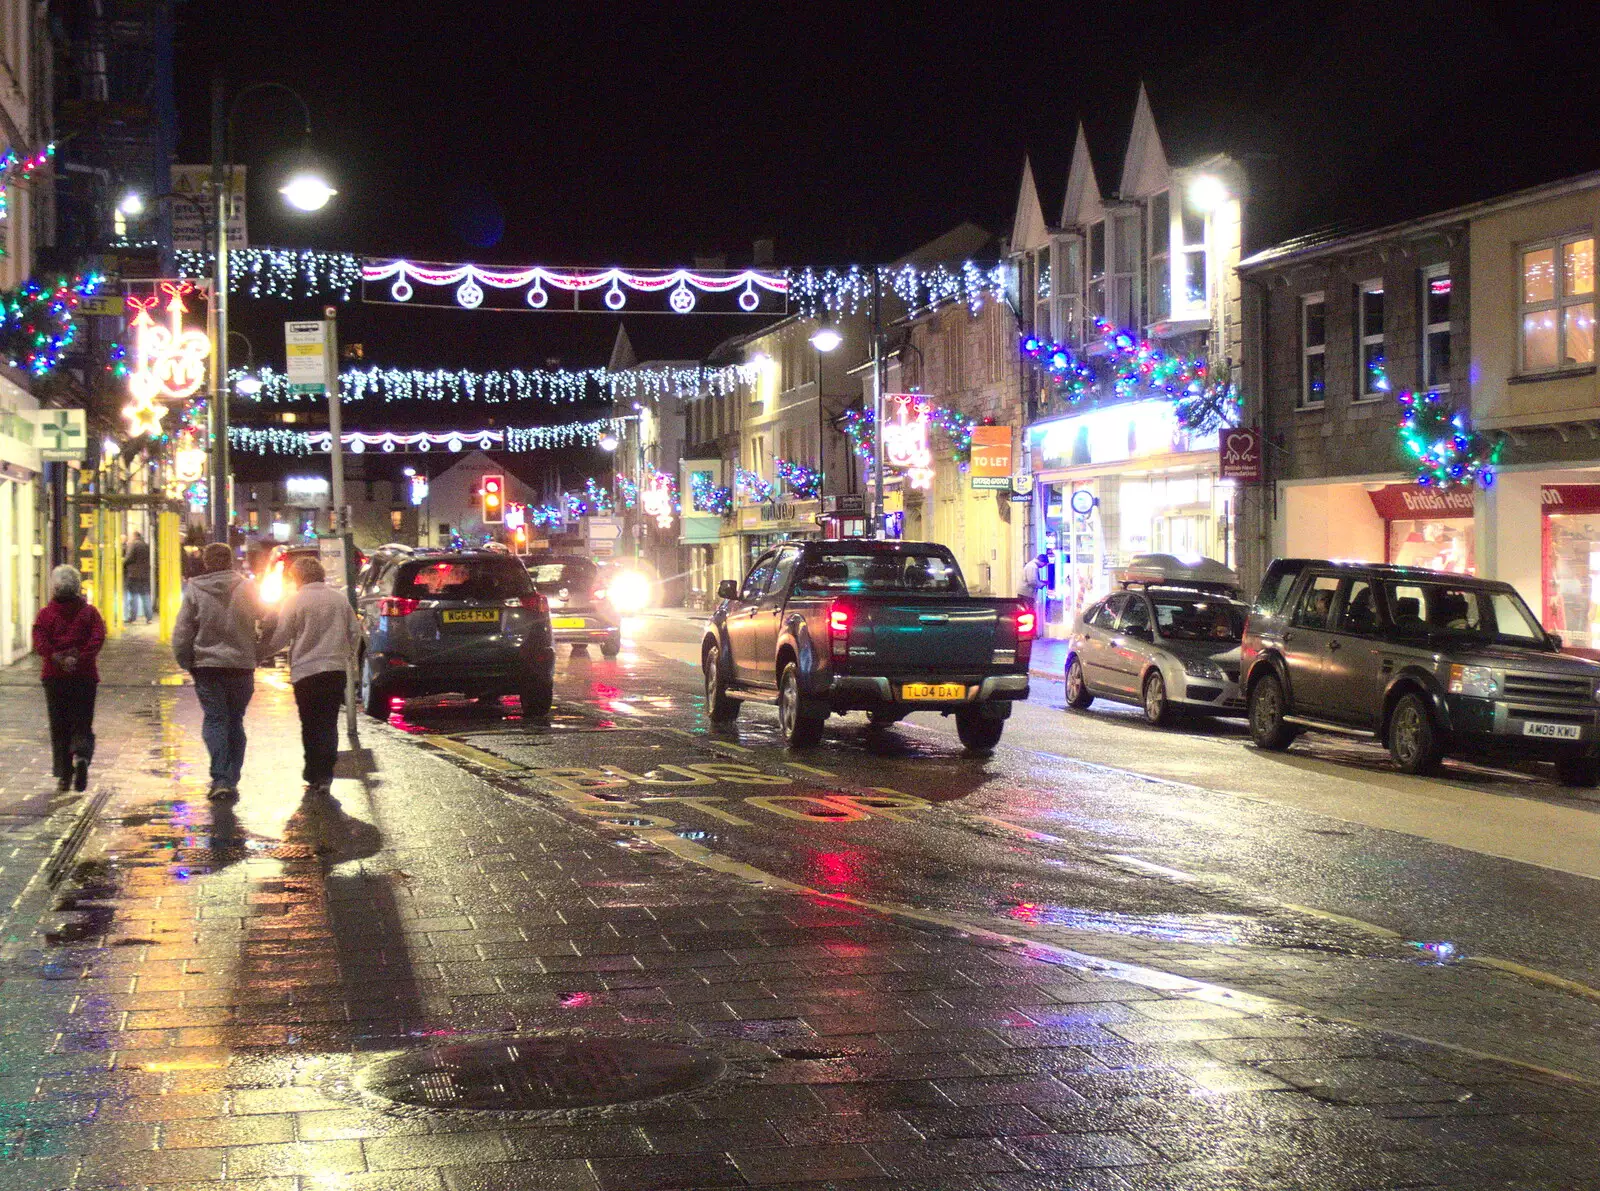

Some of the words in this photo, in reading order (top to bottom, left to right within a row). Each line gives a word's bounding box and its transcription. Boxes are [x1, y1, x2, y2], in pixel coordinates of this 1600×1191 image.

[974, 457, 988, 466] TO
[990, 457, 1008, 467] LET
[1402, 489, 1446, 510] British
[907, 686, 935, 698] TL04
[937, 686, 960, 698] DAY
[1528, 724, 1555, 736] AM08
[532, 762, 794, 790] BUS
[577, 787, 932, 829] STOP
